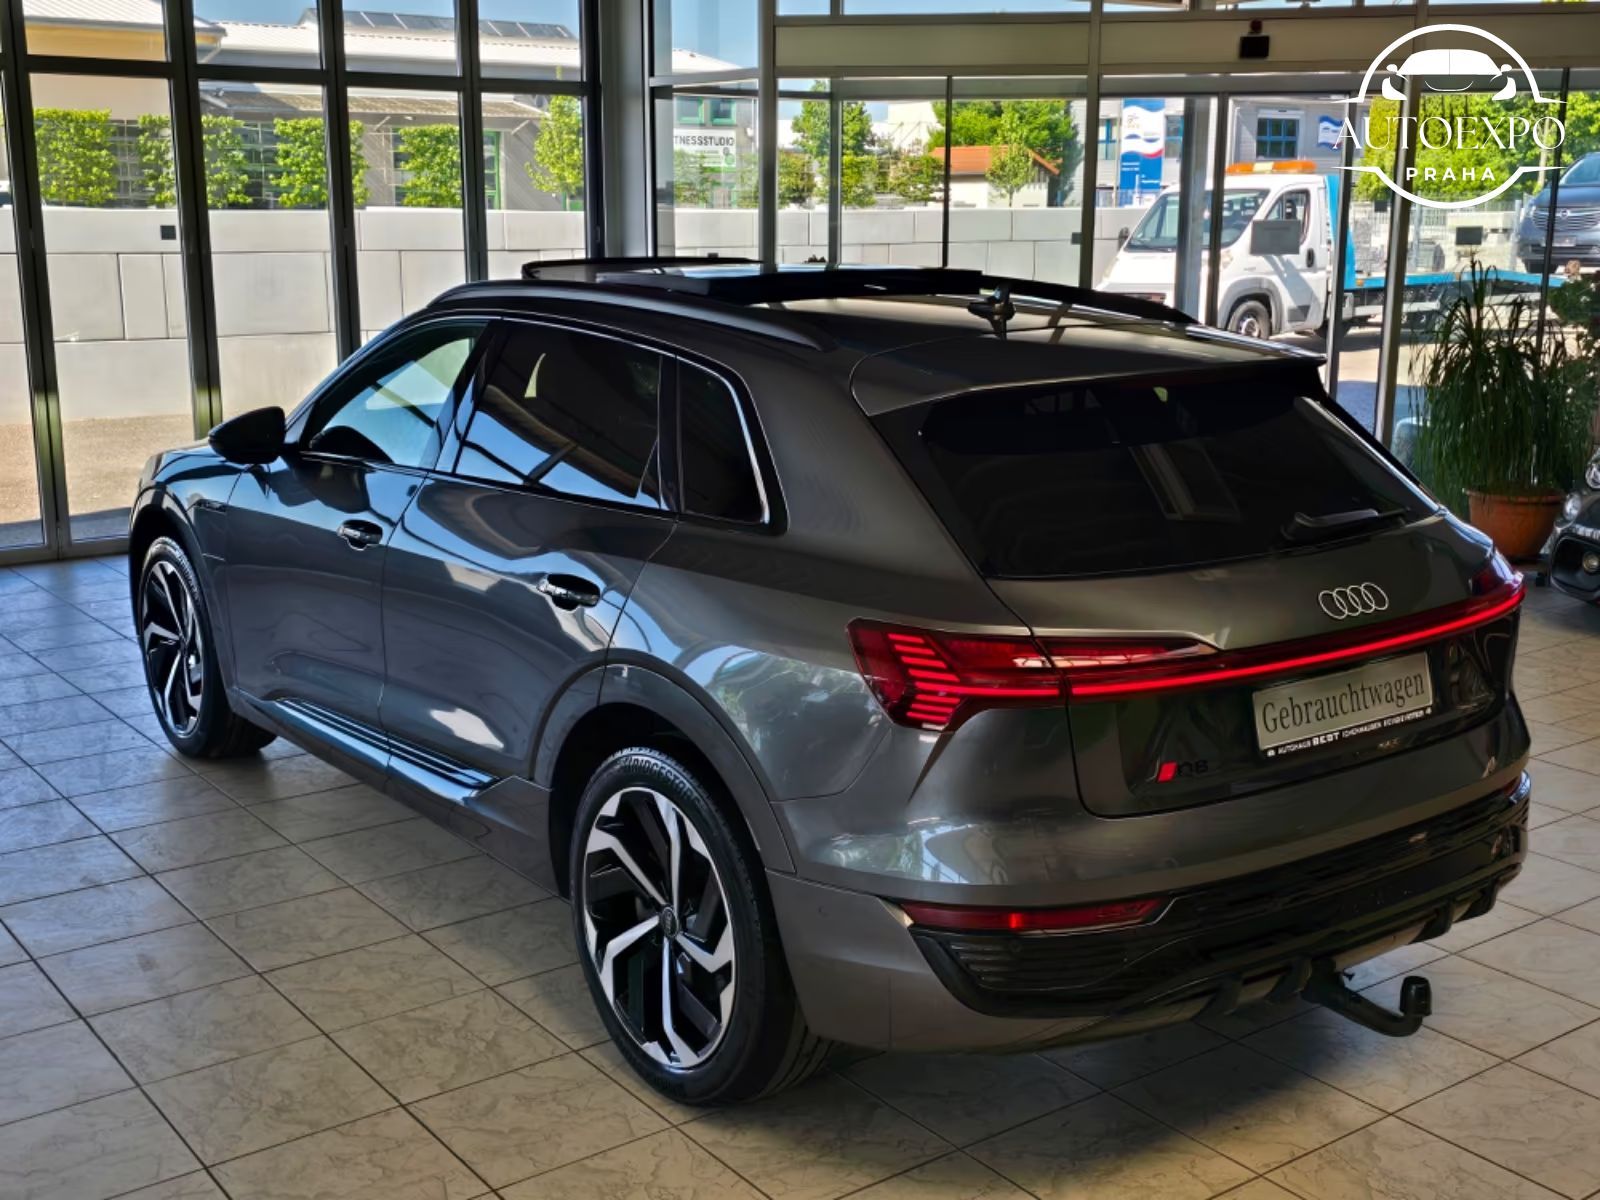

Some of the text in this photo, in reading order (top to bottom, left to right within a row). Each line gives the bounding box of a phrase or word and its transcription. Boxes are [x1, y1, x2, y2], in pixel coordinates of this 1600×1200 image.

[673, 135, 735, 146] TNESSSTUDIO
[1262, 672, 1425, 733] Gebrauchtwagen
[1311, 731, 1340, 746] BEST
